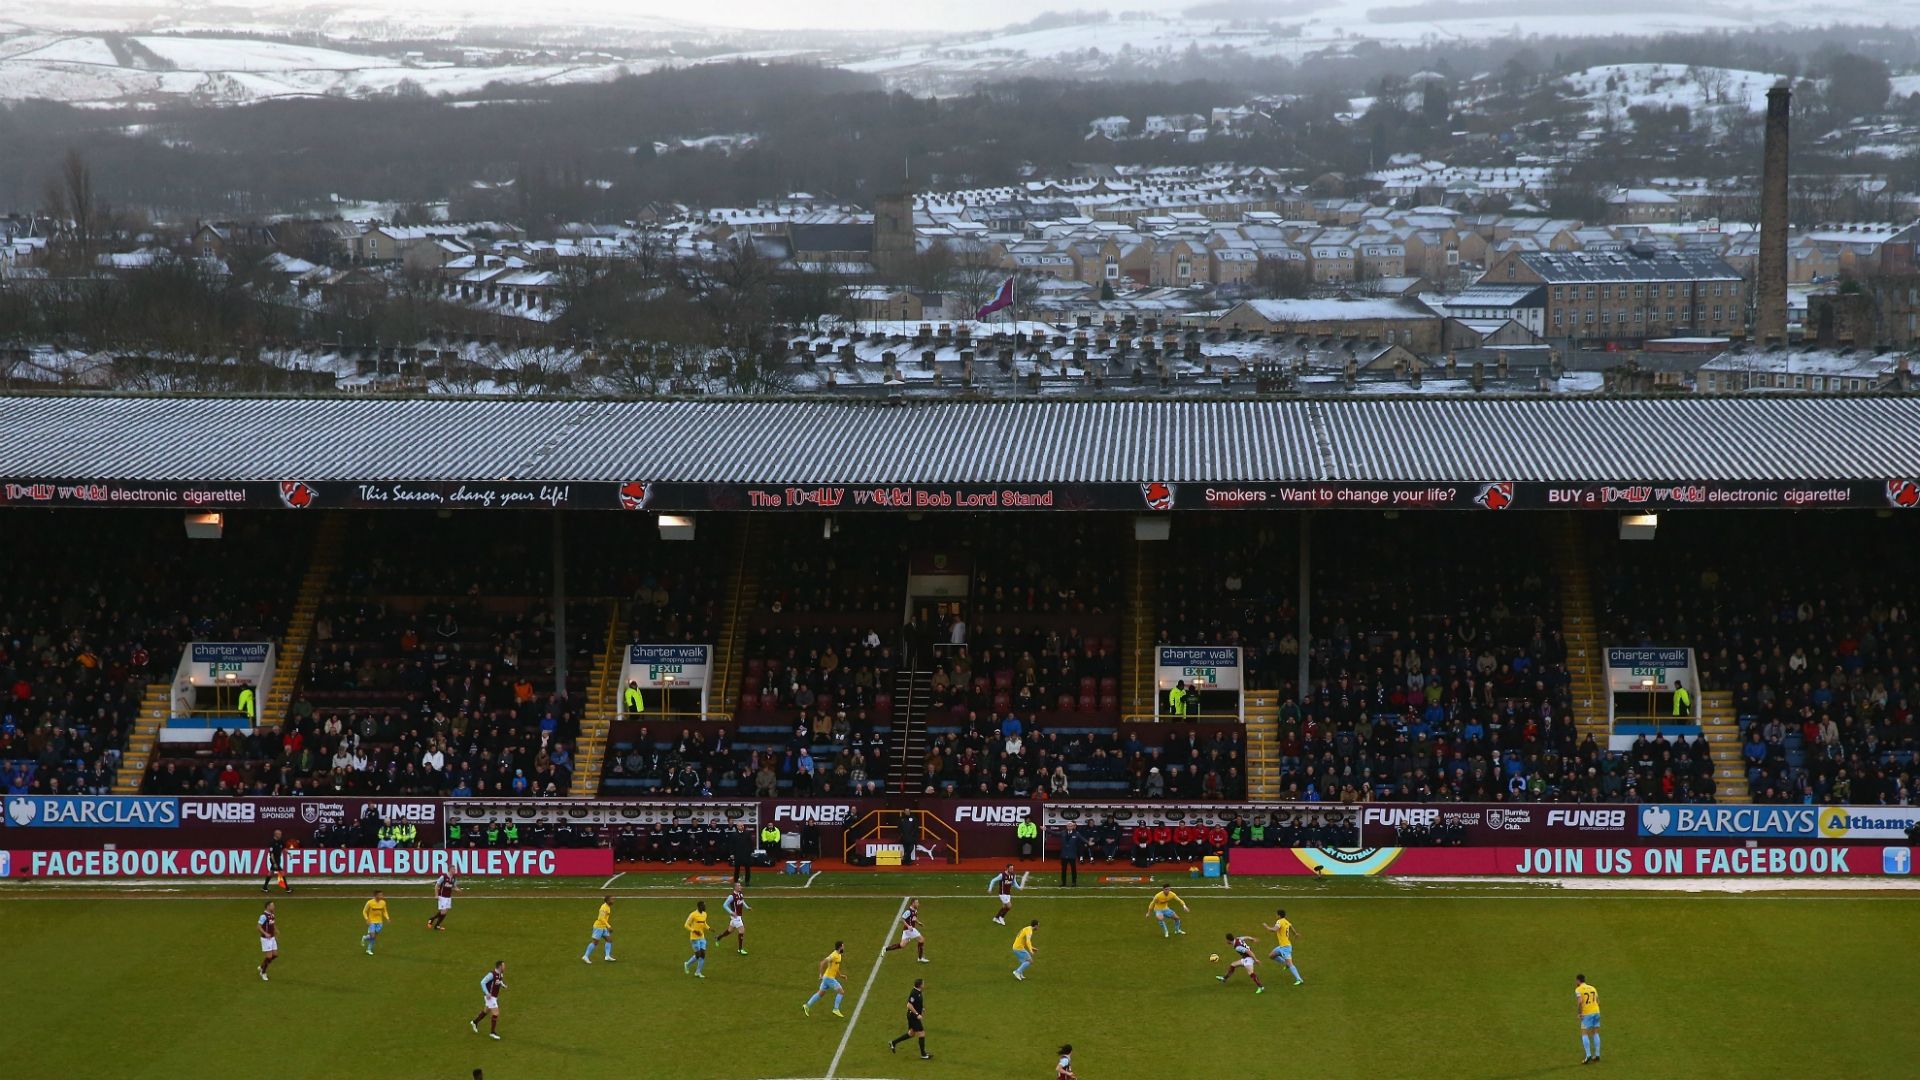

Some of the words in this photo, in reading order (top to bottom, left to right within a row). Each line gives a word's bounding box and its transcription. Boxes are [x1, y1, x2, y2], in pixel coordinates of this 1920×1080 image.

[110, 488, 178, 501] electronic
[183, 488, 247, 504] cigarette!
[359, 485, 388, 502] This
[392, 485, 444, 504] Season,
[450, 485, 496, 506] change
[500, 490, 534, 506] your
[539, 485, 569, 507] life!
[748, 490, 782, 507] The
[916, 490, 952, 507] Bob
[956, 490, 997, 507] Lord
[1001, 490, 1053, 507] Stand
[1204, 488, 1267, 502] Smokers
[1280, 488, 1317, 502] Want
[1320, 488, 1334, 502] to
[1337, 487, 1390, 506] change
[1392, 490, 1424, 504] your
[1427, 487, 1457, 502] life?
[1549, 489, 1583, 502] BUY
[1586, 491, 1595, 502] a
[1708, 488, 1778, 501] electronic
[1783, 487, 1851, 504] cigarette!
[195, 645, 238, 655] charter
[241, 645, 267, 655] walk
[633, 647, 676, 657] charter
[679, 647, 704, 657] walk
[1162, 648, 1206, 659] charter
[1209, 649, 1235, 659] walk
[1611, 650, 1656, 660] charter
[1659, 650, 1685, 660] walk
[218, 663, 241, 671] EXIT
[657, 664, 681, 673] EXIT
[1184, 668, 1207, 676] EXT
[1633, 668, 1657, 676] EXIT
[43, 800, 175, 824] BARCLAYS
[181, 802, 255, 820] FUN88
[320, 803, 344, 811] Burnley
[320, 809, 345, 817] Football
[774, 805, 850, 821] FUN88
[955, 806, 1031, 823] FUN88
[1504, 809, 1530, 818] Burnley
[320, 816, 336, 824] Club.
[1364, 808, 1440, 825] FUN88
[1504, 816, 1531, 824] Football
[1546, 810, 1626, 827] FUN88
[1677, 809, 1815, 833] BARCLAYS
[1827, 814, 1915, 830] Althams
[1515, 848, 1583, 874] JOIN
[1596, 848, 1633, 874] US
[1644, 848, 1683, 874] ON
[1696, 847, 1850, 874] FACEBOOK
